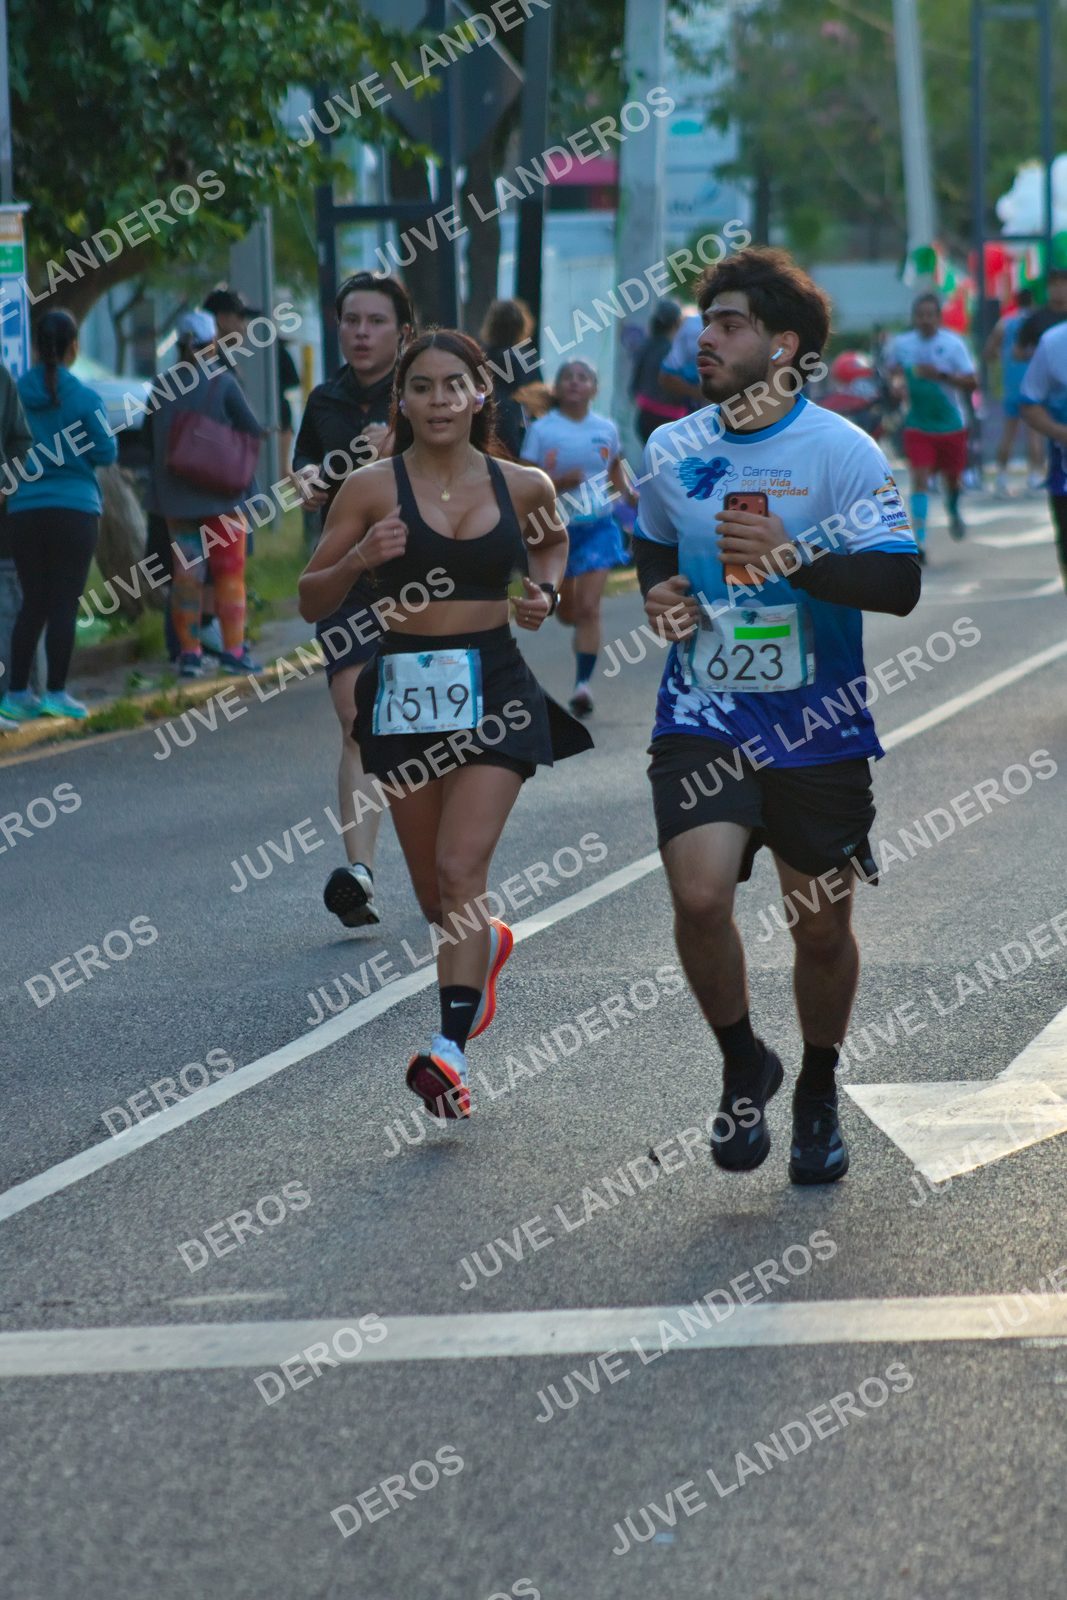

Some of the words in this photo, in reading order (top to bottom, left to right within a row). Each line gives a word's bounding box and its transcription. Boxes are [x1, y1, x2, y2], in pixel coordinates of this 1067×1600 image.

[742, 466, 792, 478] Carrera
[769, 478, 791, 487] Vida
[706, 643, 784, 681] 623
[386, 683, 470, 723] 1519
